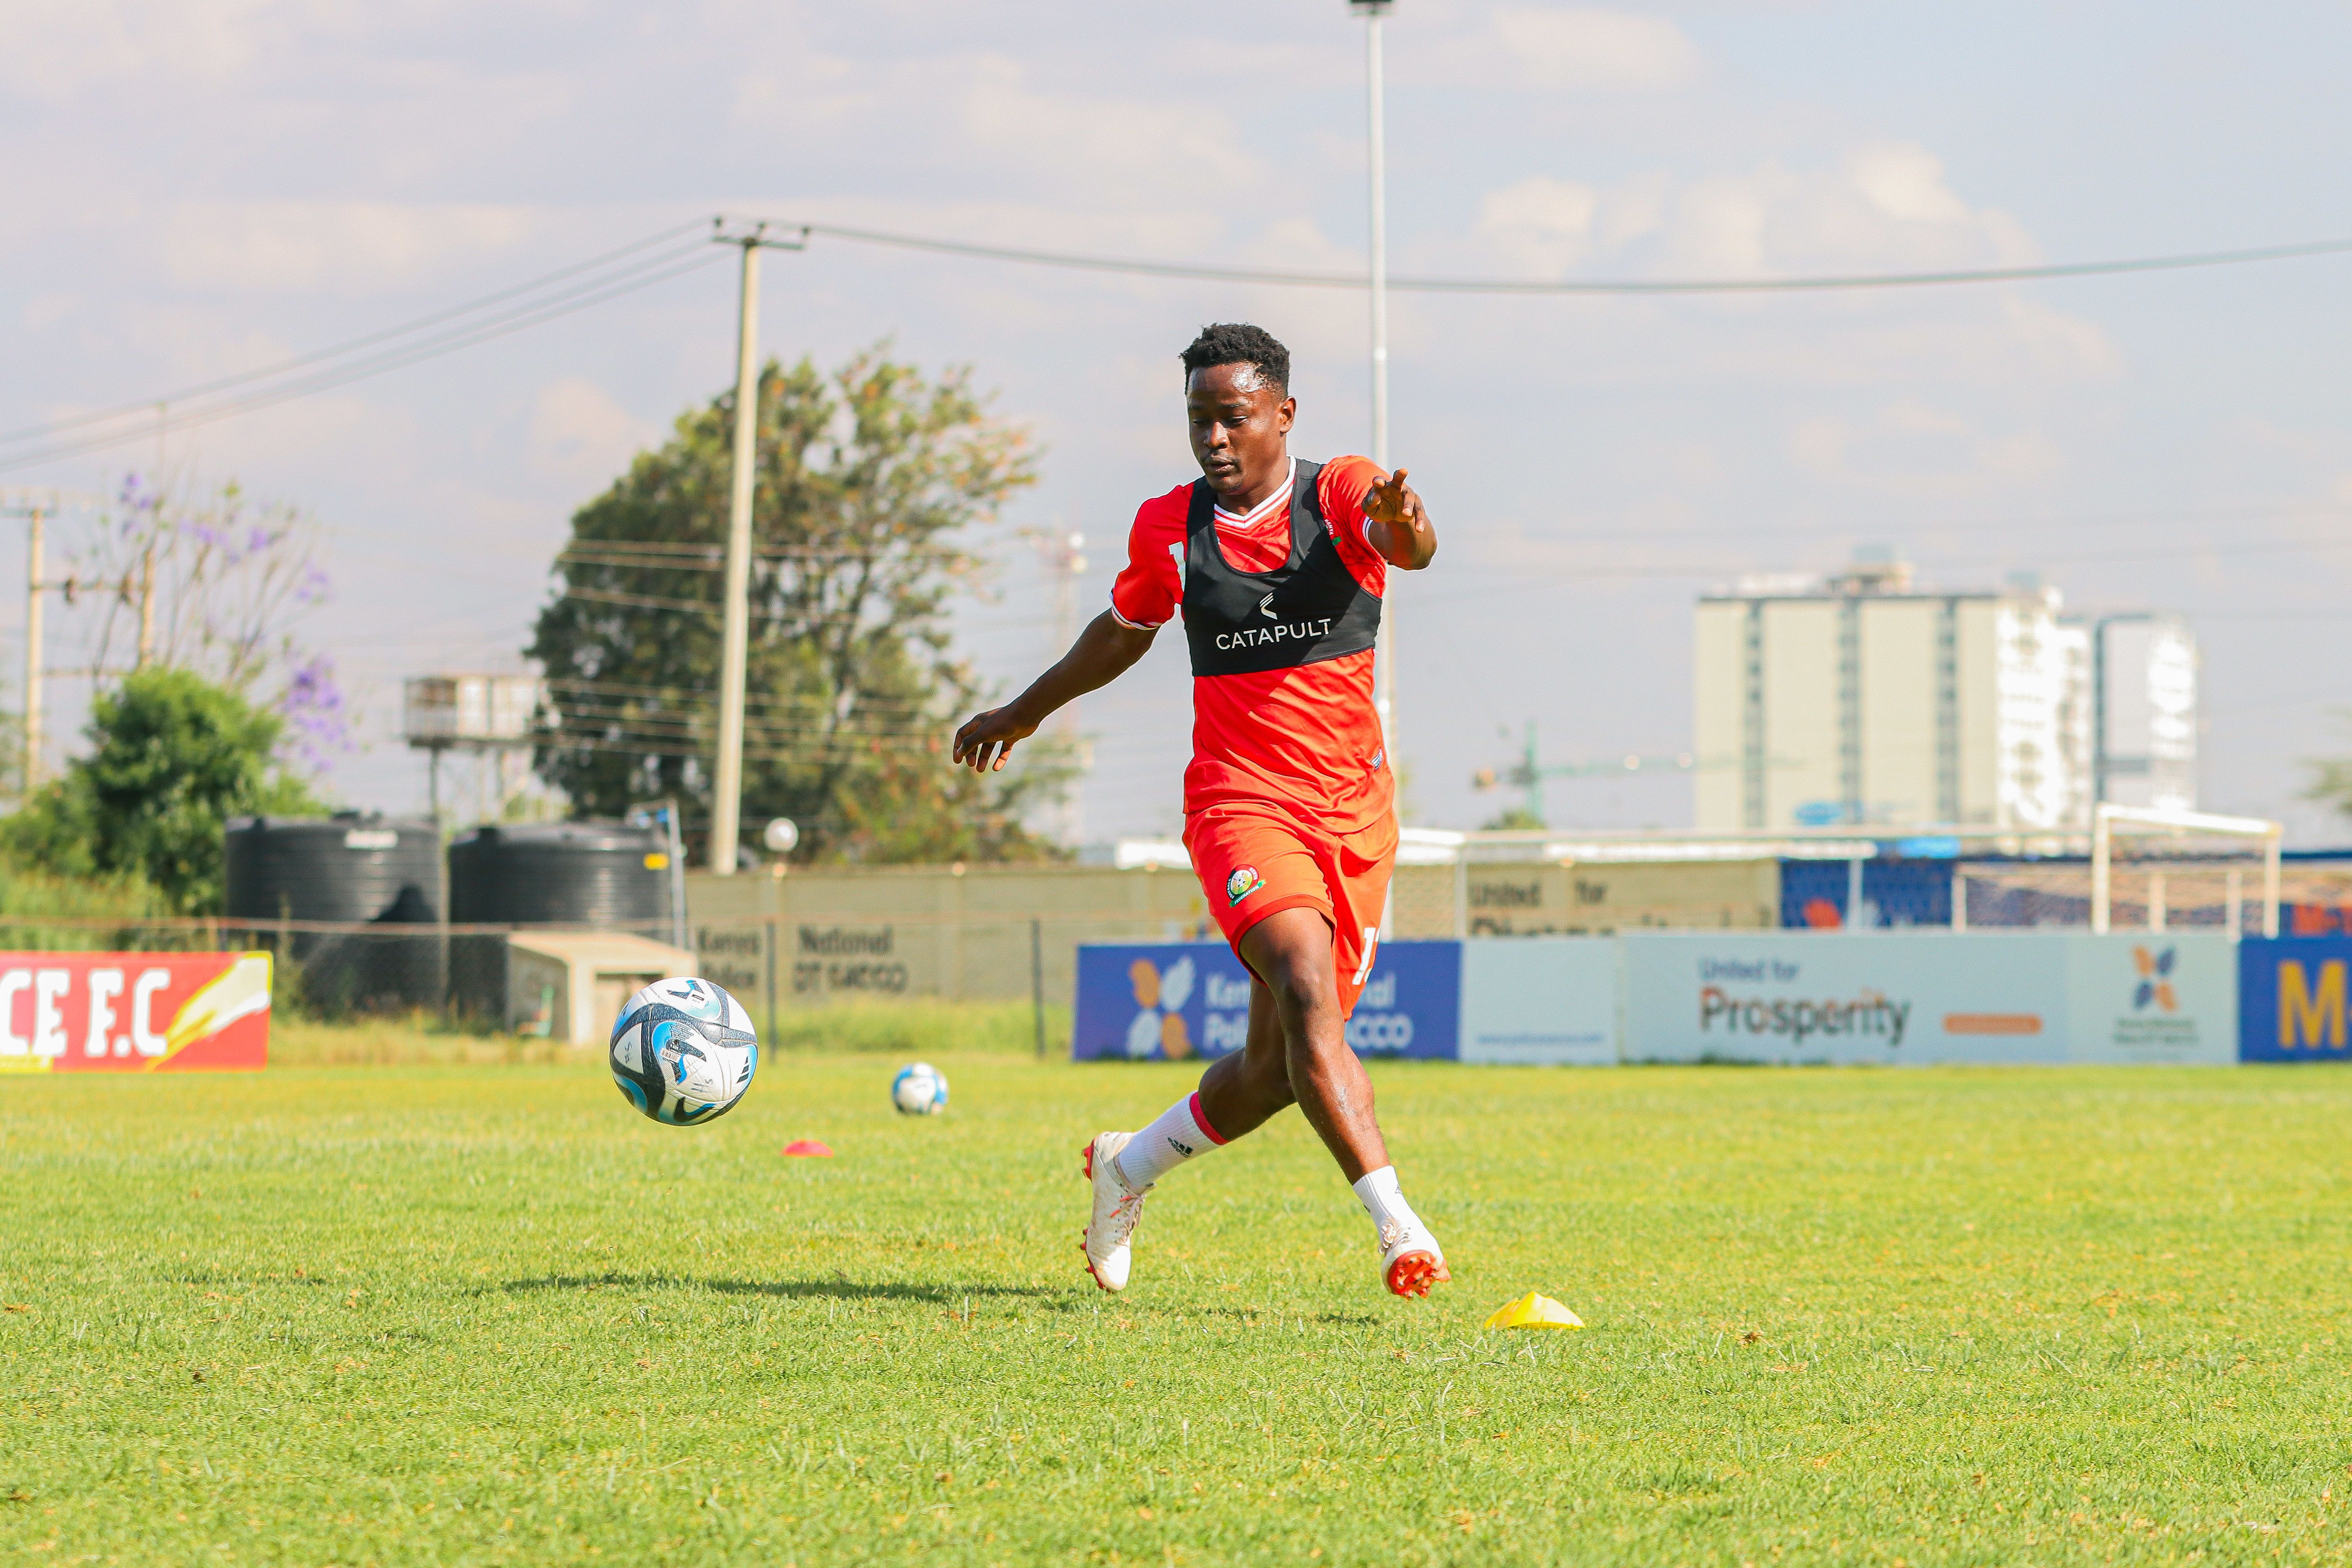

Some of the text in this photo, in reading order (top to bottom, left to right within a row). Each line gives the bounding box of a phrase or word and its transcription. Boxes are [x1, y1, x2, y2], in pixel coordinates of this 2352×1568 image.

[1324, 519, 1334, 535] KENYA
[1216, 618, 1332, 650] CATAPULT
[1235, 885, 1259, 905] FEDERATION
[1352, 927, 1381, 986] 1
[1700, 985, 1912, 1048] Prosperity
